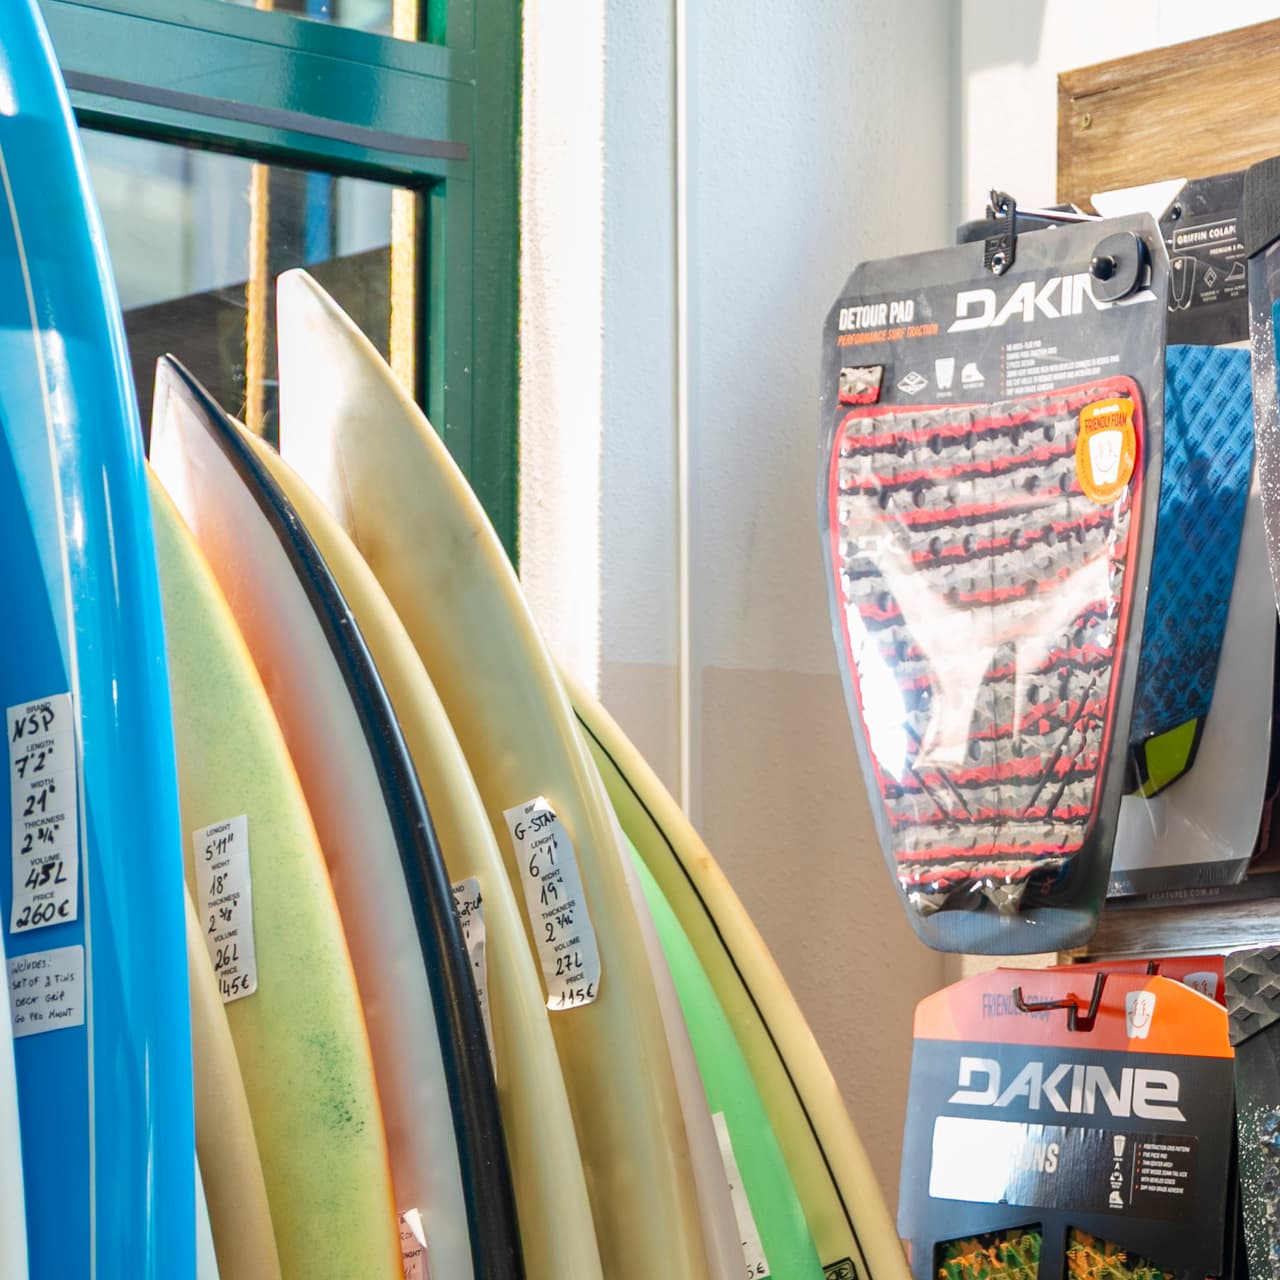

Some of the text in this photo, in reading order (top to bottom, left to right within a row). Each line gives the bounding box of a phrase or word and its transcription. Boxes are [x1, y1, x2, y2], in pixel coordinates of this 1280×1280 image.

[1176, 231, 1207, 245] GRIFFIN
[947, 271, 1158, 333] DAKIN
[839, 298, 915, 331] DETOUR PAD
[1085, 416, 1110, 432] FRIENDLY
[12, 707, 55, 742] NSP
[26, 740, 54, 753] LENGTH
[31, 778, 54, 789] WIDTH
[24, 813, 65, 830] THICKNESS
[206, 823, 231, 837] LENGHT
[21, 833, 33, 855] 2
[531, 833, 556, 849] LENGHT
[30, 853, 60, 866] VOLUME
[541, 868, 561, 883] WIDHT
[32, 891, 55, 902] PRICE
[208, 892, 240, 908] THICKNESS
[16, 900, 69, 928] 260€
[541, 899, 577, 921] THICKNESS
[207, 914, 217, 934] 2
[213, 928, 239, 943] VOLUME
[545, 922, 557, 943] 2
[553, 935, 581, 952] VOLUME
[214, 943, 239, 971] 26L
[555, 952, 583, 976] 27L
[220, 966, 238, 978] PRICE
[565, 972, 585, 986] PRICE
[948, 1056, 1187, 1122] DAKINE
